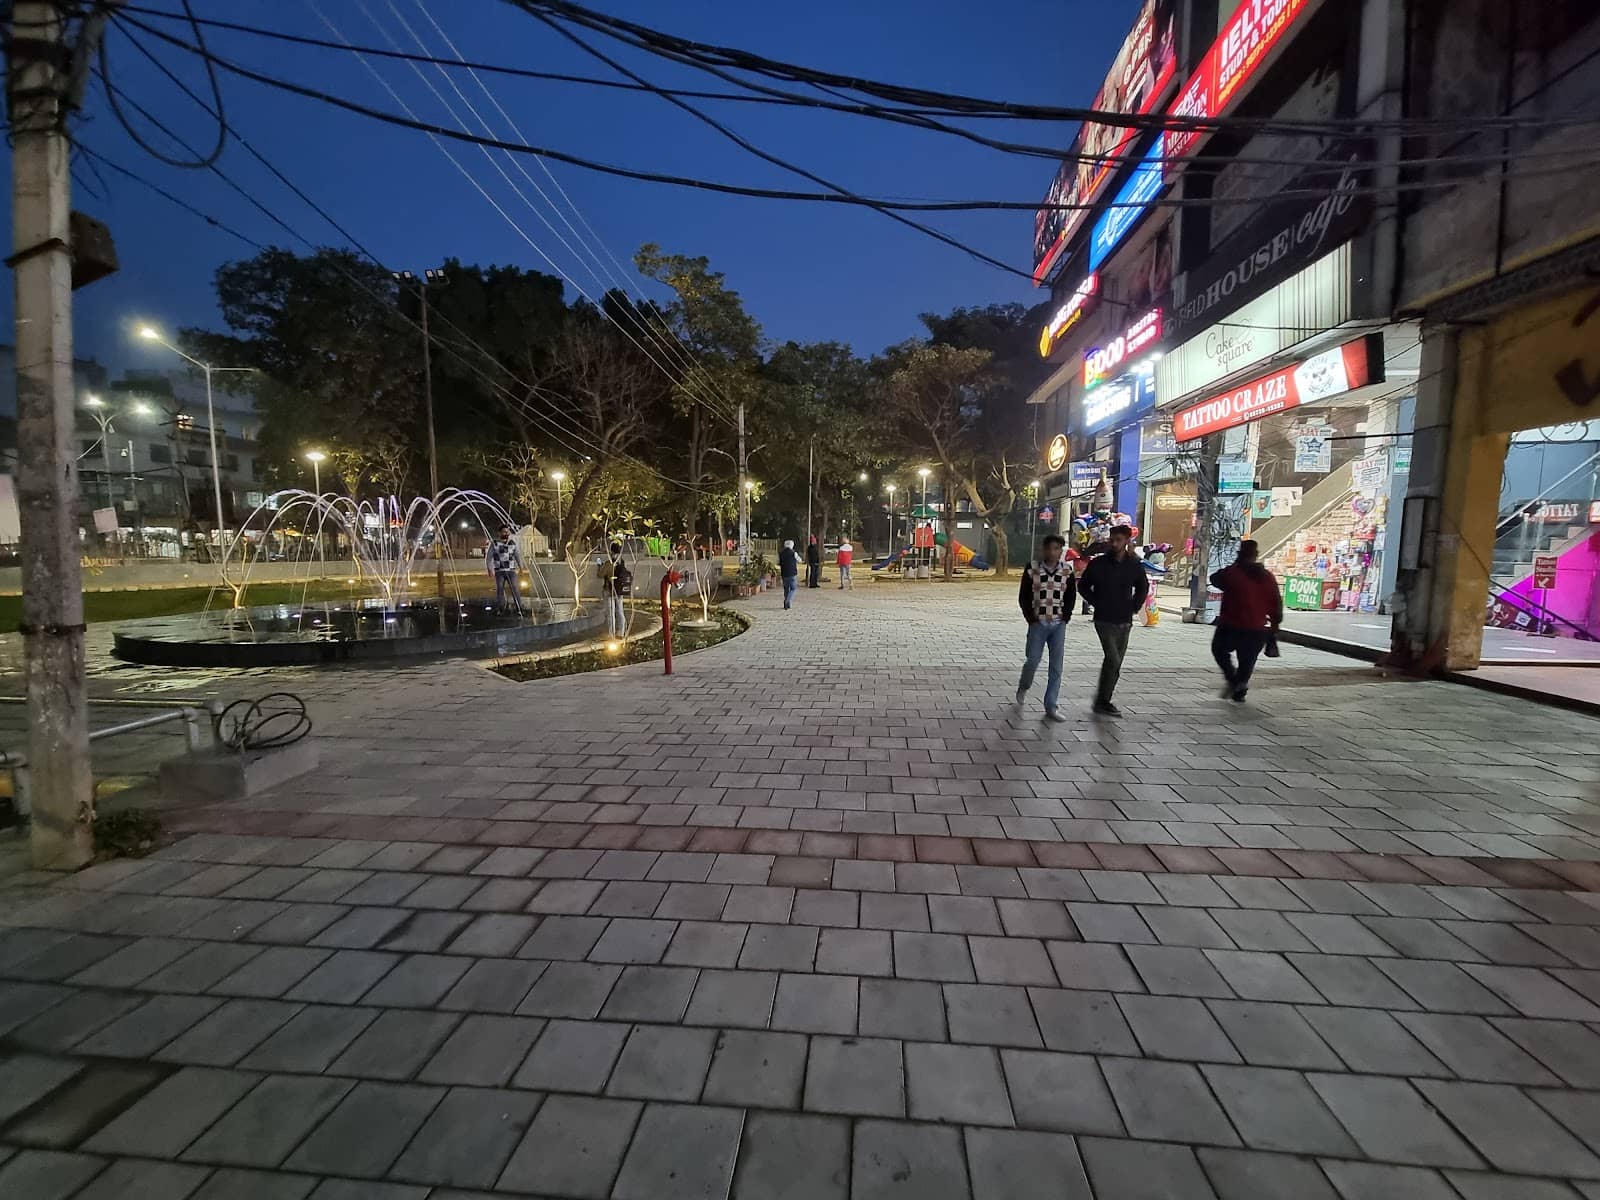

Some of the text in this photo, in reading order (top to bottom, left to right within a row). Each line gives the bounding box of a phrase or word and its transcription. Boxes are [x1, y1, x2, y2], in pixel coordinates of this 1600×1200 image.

[1219, 38, 1250, 89] STUDY
[1205, 228, 1290, 309] HOUSE
[1205, 325, 1234, 359] Cake
[1218, 340, 1254, 372] square
[1183, 375, 1288, 431] TATTOO CRAZE
[1289, 578, 1319, 594] BOOK
[1297, 593, 1317, 605] STALL
